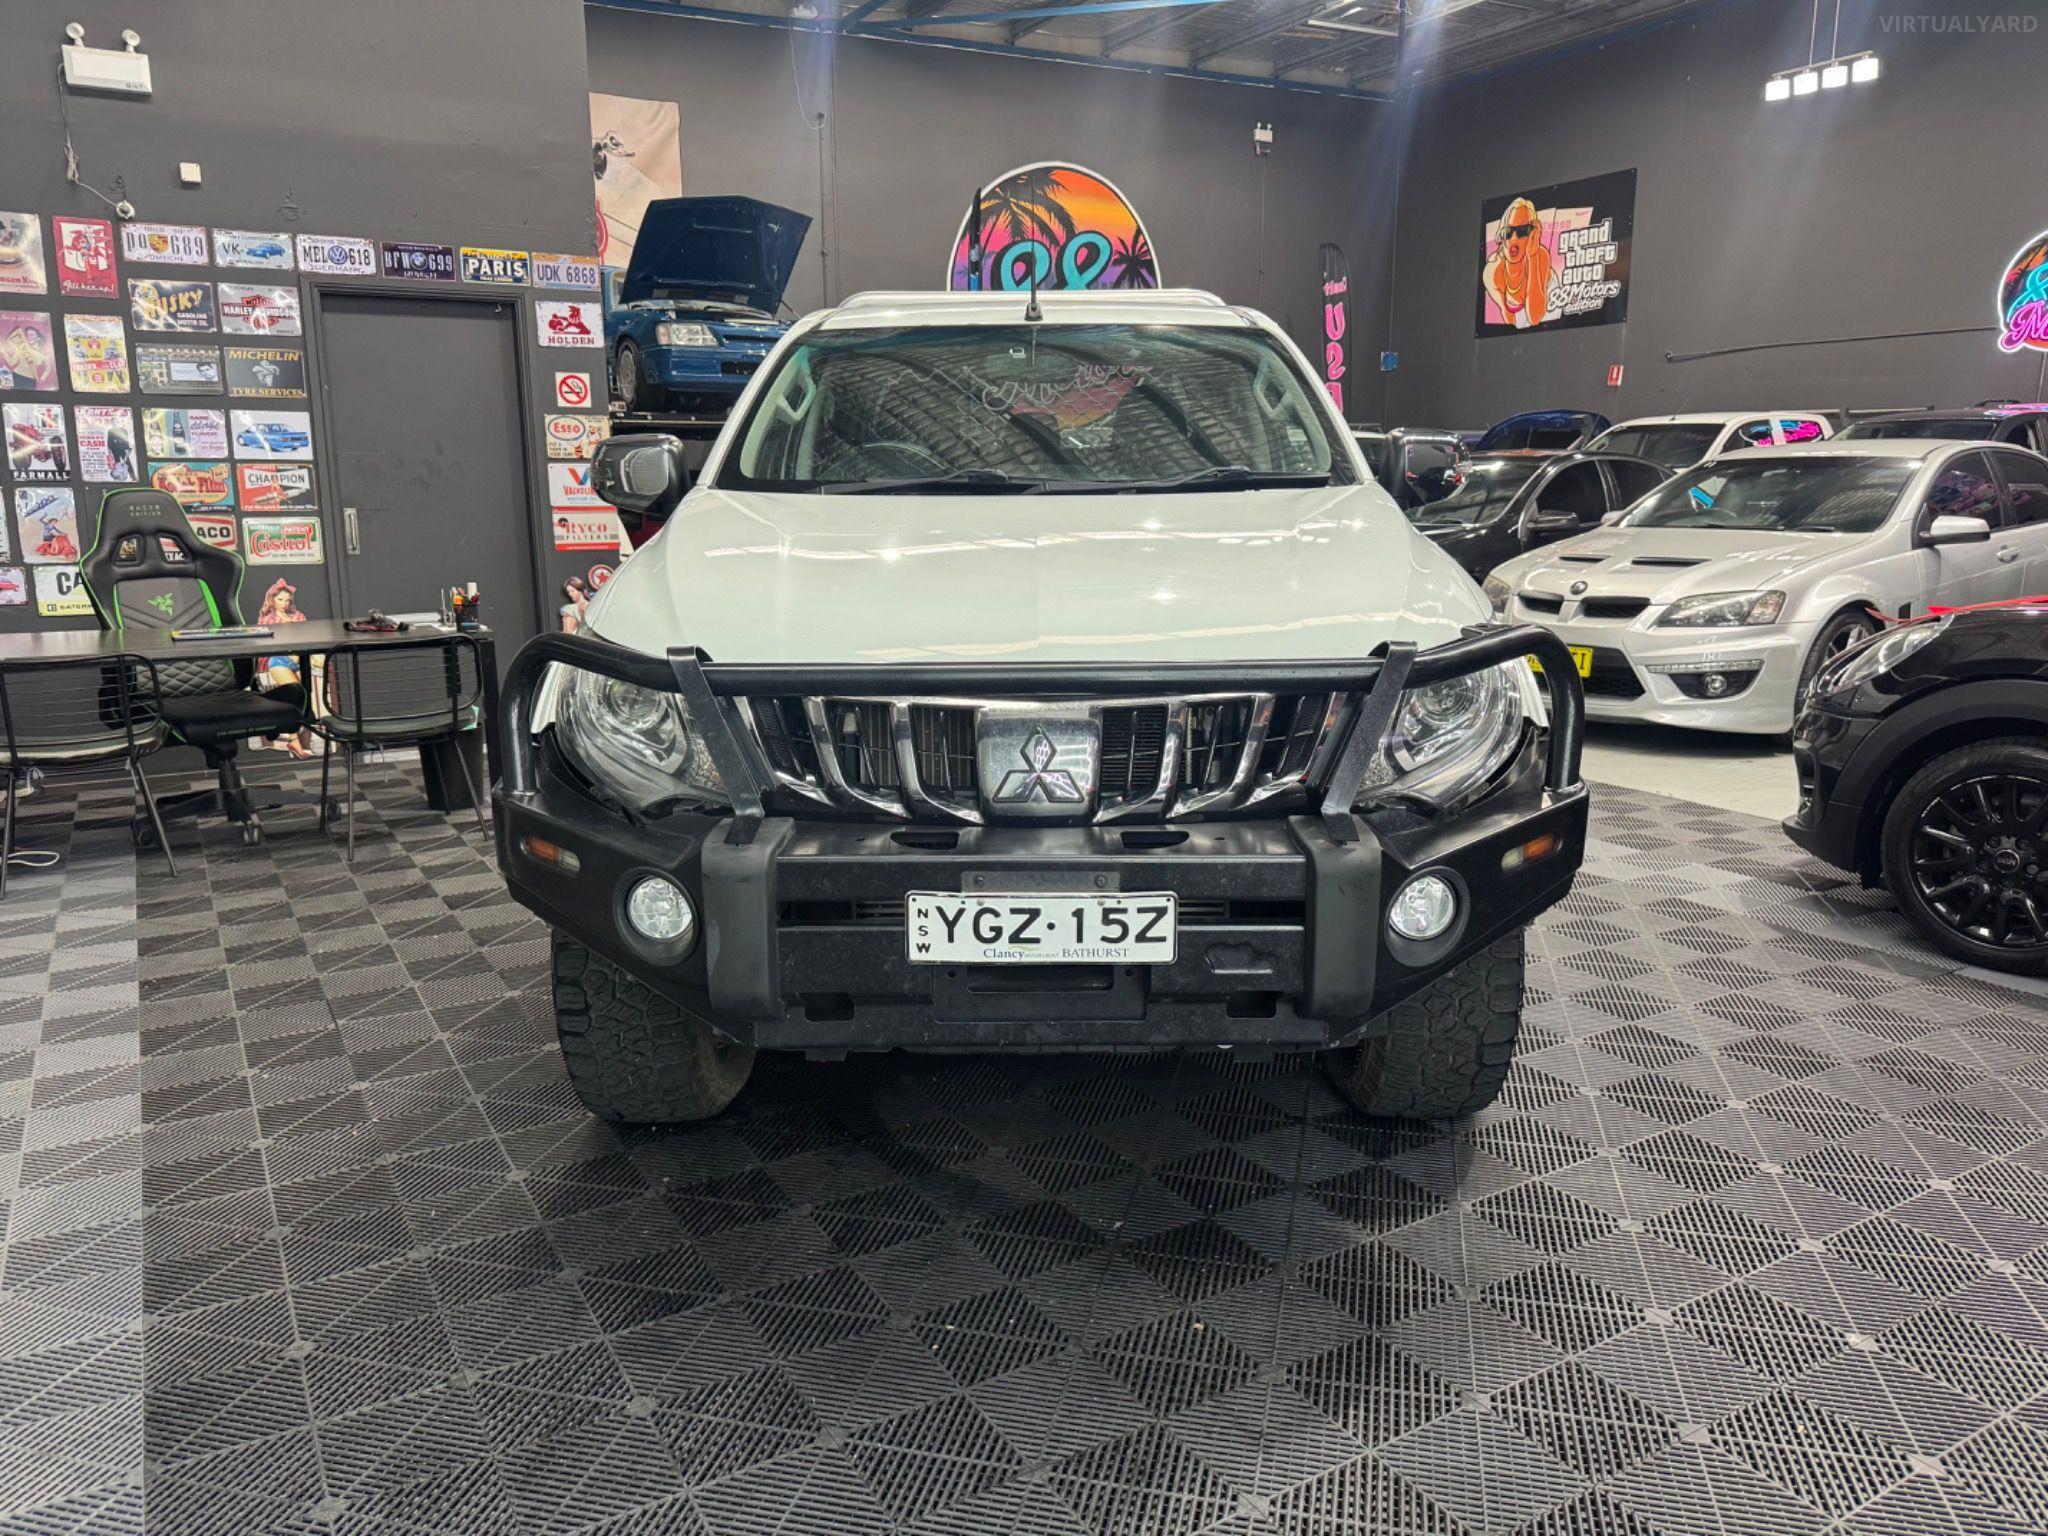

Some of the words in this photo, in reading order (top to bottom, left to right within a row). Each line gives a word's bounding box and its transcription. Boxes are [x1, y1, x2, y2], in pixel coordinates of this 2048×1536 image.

[170, 234, 203, 257] 689
[1559, 220, 1611, 254] grand
[303, 245, 328, 263] MEL
[349, 248, 371, 266] 618
[428, 253, 453, 272] 699
[1565, 243, 1616, 268] theft
[469, 258, 523, 277] PARIS
[537, 263, 561, 282] UDK
[566, 265, 596, 284] 6868
[1562, 264, 1603, 285] auto
[548, 336, 595, 345] HOLDEN
[229, 350, 299, 361] MICHELIN
[232, 387, 256, 396] TYRE
[258, 387, 303, 397] SERVICES
[13, 470, 70, 479] FARMALL
[197, 526, 231, 539] ACO
[563, 523, 608, 533] RYCO
[251, 524, 313, 557] Castrol
[56, 572, 84, 596] CA
[916, 907, 931, 954] NSW
[983, 947, 1025, 960] Clancy
[1062, 947, 1130, 958] BATHURST
